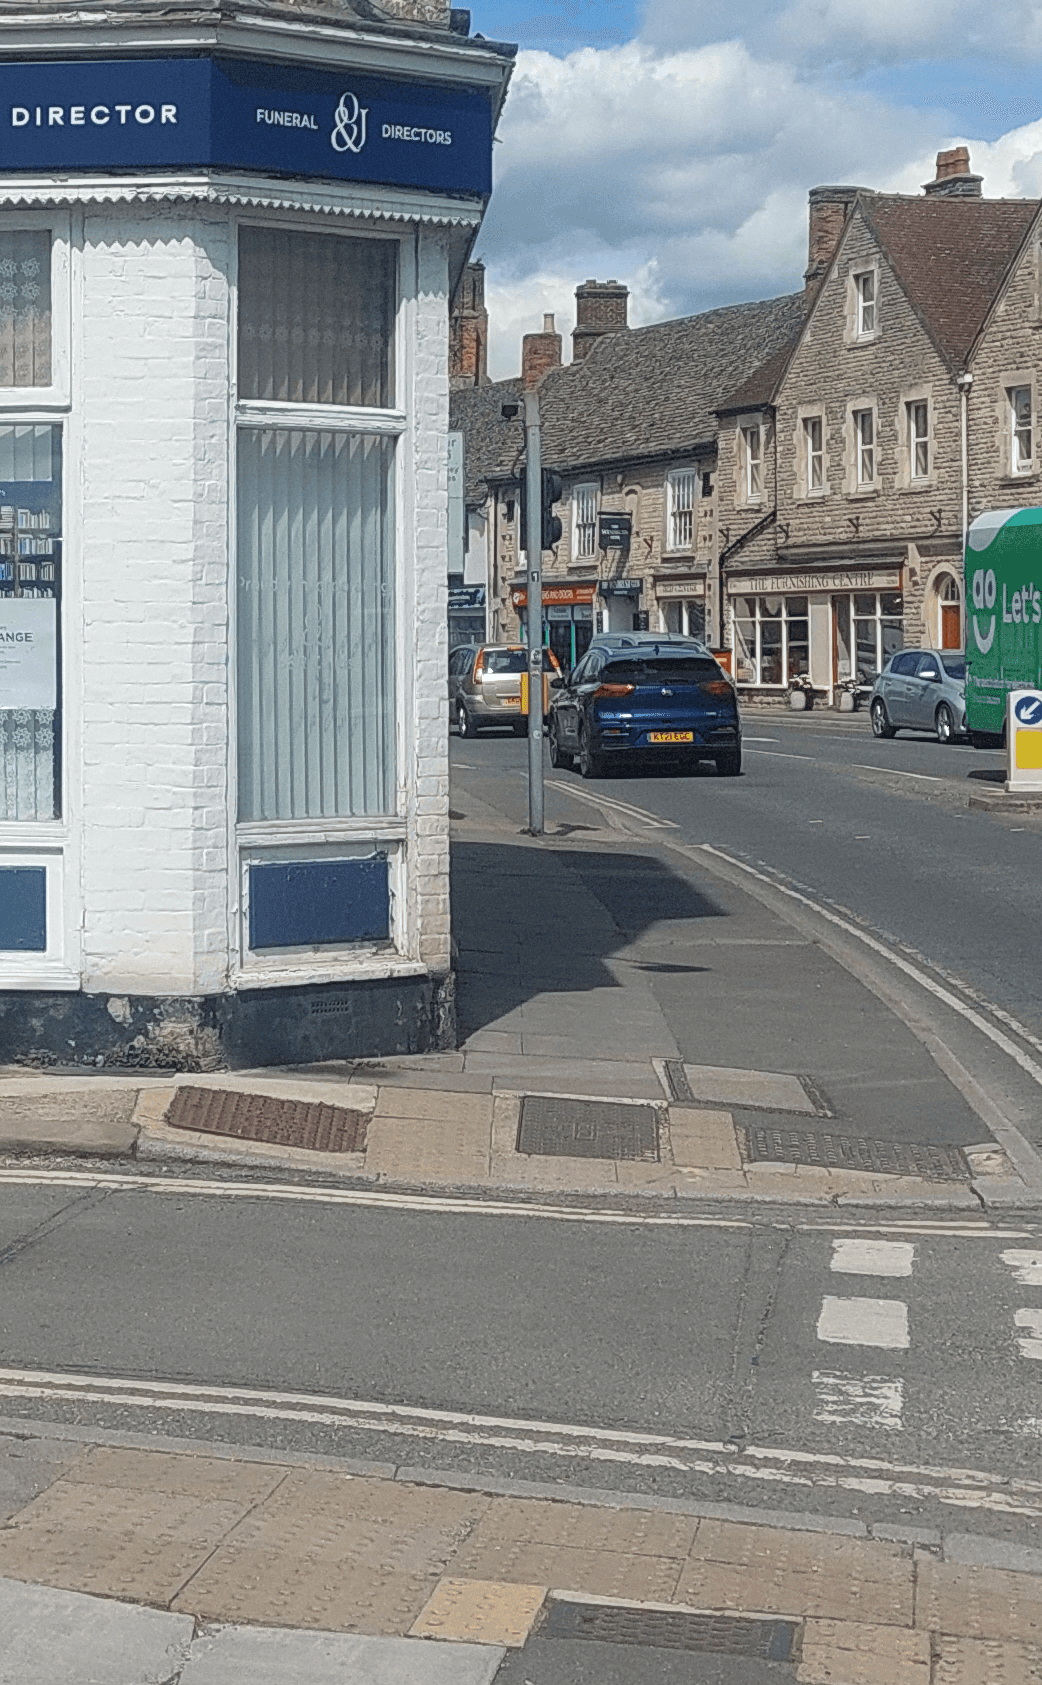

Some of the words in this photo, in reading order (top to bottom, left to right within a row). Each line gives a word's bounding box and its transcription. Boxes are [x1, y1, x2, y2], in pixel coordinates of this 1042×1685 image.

[11, 104, 178, 128] DIRECTOR
[256, 108, 319, 130] FUNERAL
[381, 123, 452, 145] DIRECTORS
[748, 577, 768, 591] THE
[770, 574, 829, 591] FURNISHING
[832, 571, 875, 587] CENTRE
[1002, 581, 1042, 624] Let's
